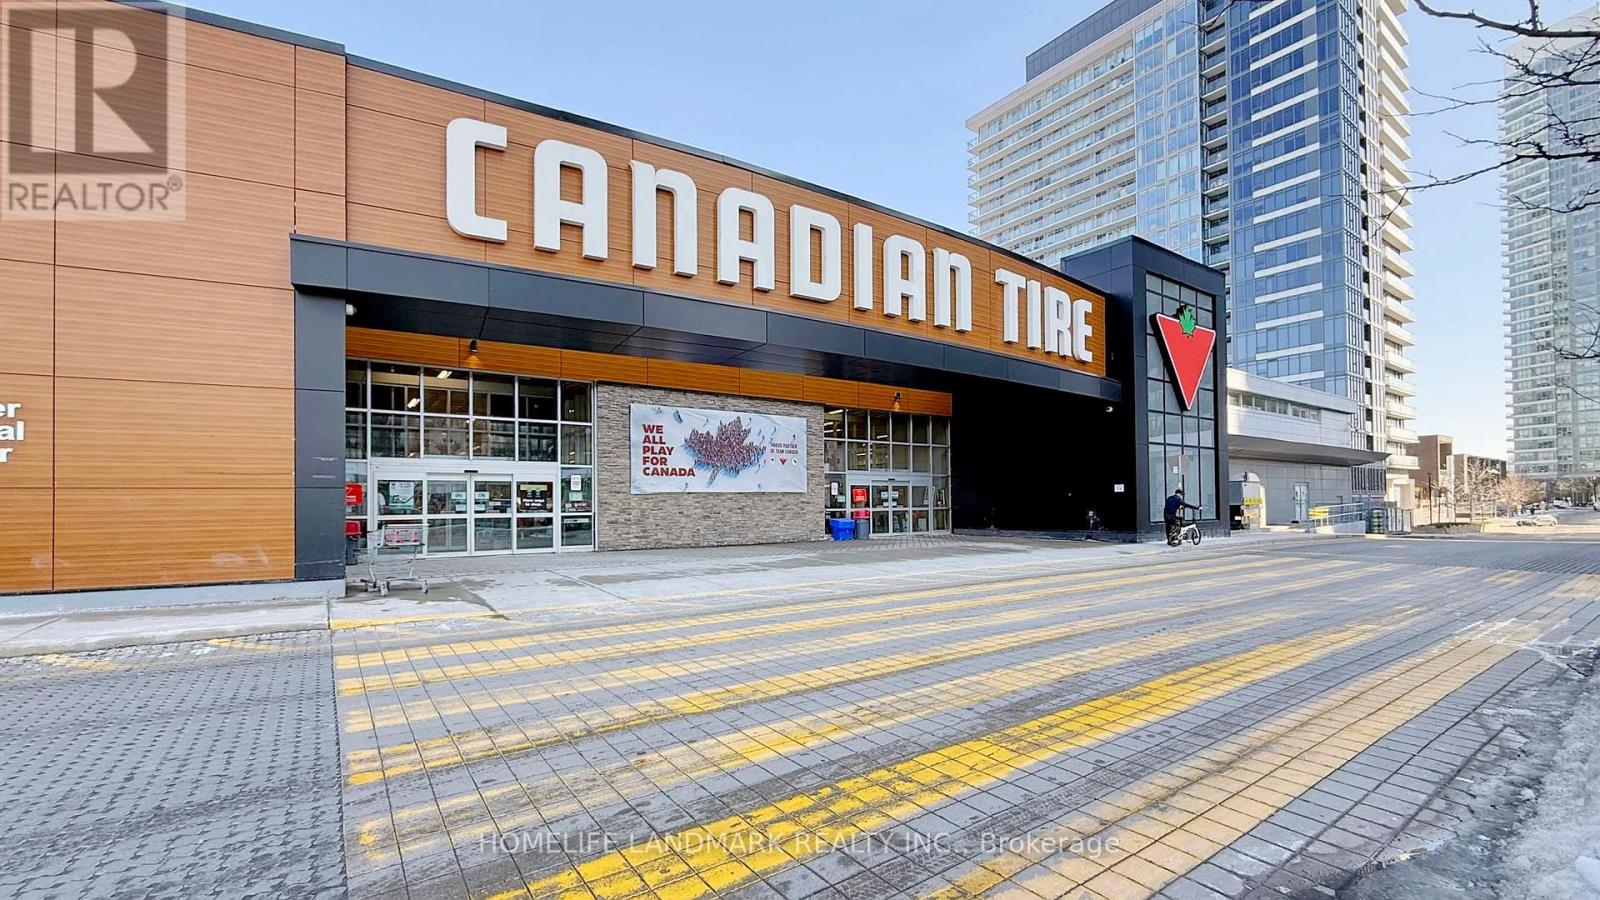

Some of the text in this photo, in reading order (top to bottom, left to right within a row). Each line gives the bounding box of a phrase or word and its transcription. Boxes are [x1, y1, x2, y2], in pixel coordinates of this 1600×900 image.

[446, 117, 1093, 363] CANADIAN TIRE
[642, 424, 664, 434] WE
[642, 435, 666, 445] ALL
[642, 445, 675, 456] PLAY
[642, 456, 668, 466] FOR
[642, 467, 696, 477] CANADA
